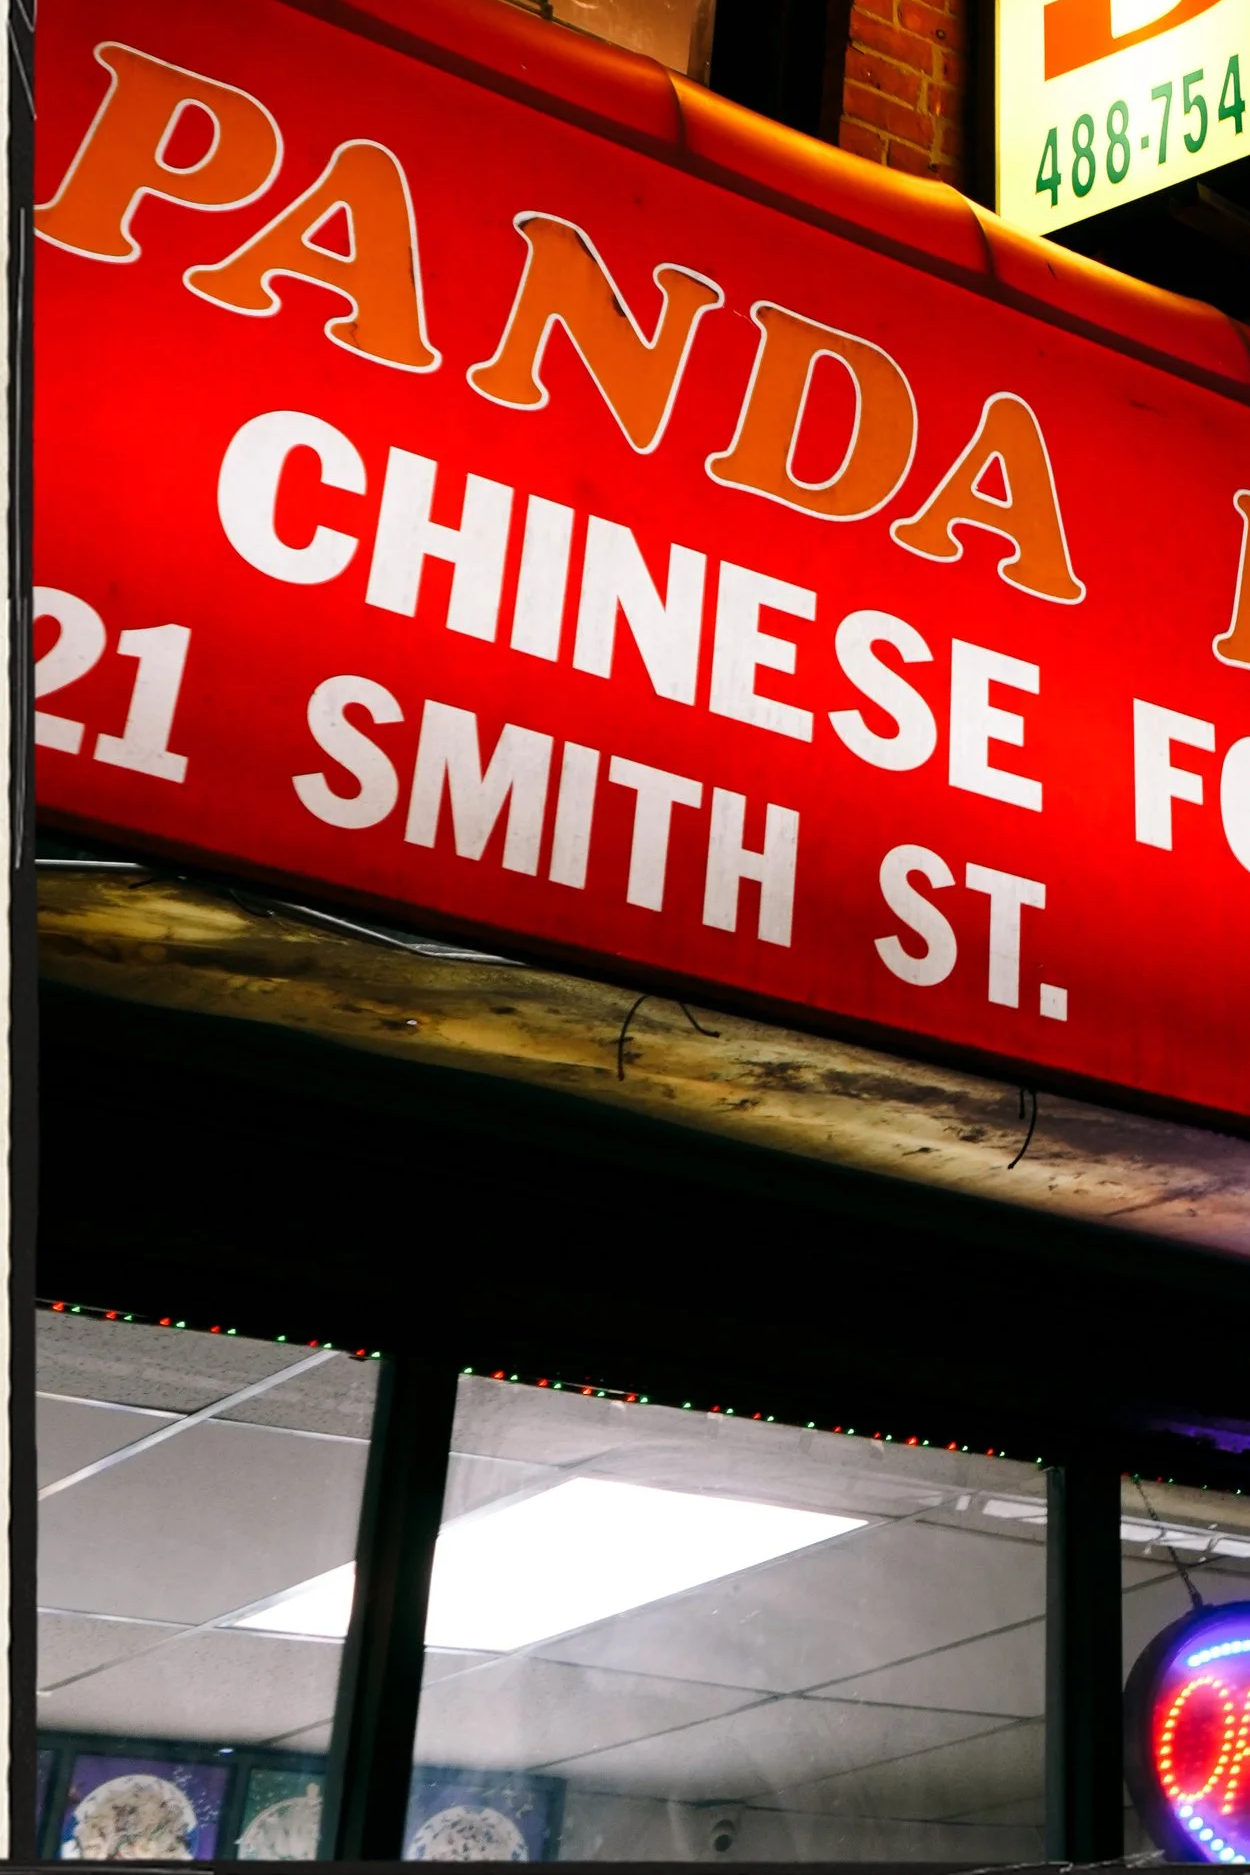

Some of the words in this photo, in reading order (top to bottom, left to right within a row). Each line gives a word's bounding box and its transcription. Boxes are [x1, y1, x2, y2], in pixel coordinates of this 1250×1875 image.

[35, 41, 1087, 605] PANDA
[217, 410, 1043, 813] CHINESE
[292, 674, 800, 949] SMITH
[874, 844, 1068, 1022] ST.
